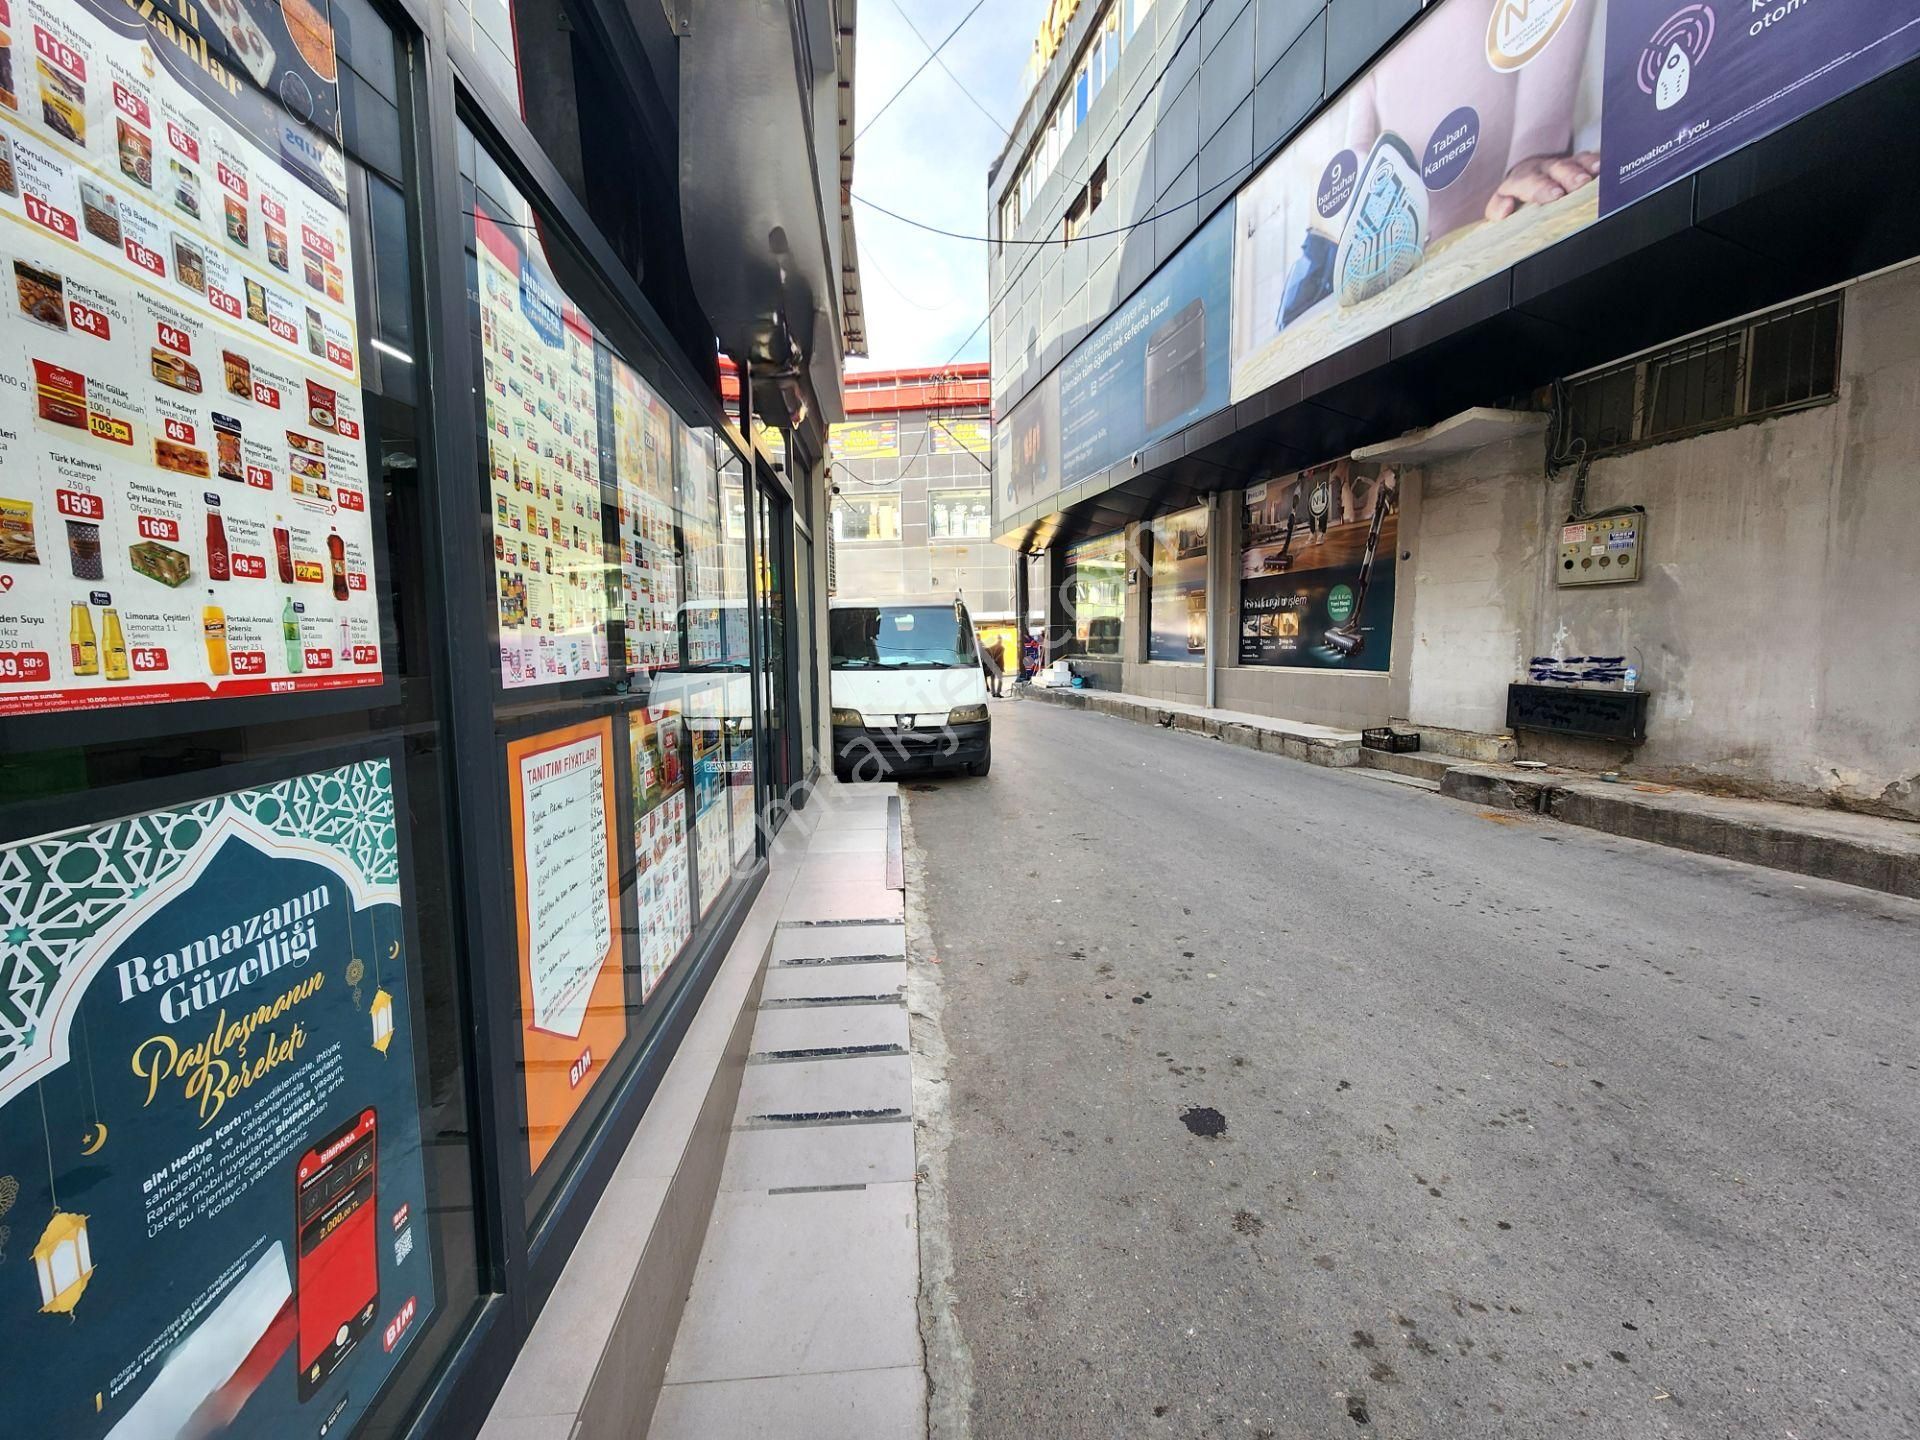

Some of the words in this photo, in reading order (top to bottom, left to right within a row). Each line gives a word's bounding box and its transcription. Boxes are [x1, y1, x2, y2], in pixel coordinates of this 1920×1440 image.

[62, 21, 92, 50] Hurma
[106, 54, 124, 74] Lulu
[1432, 124, 1468, 155] Taban
[1619, 140, 1673, 175] innovation
[1688, 119, 1710, 140] you
[13, 139, 64, 177] Kavrulmuş
[15, 153, 37, 172] Kaju
[1424, 135, 1476, 178] Kamerası
[17, 166, 52, 192] Simbat
[19, 180, 39, 196] 300
[1331, 164, 1342, 184] 9
[1318, 193, 1332, 208] bar
[1332, 171, 1357, 197] buhar
[133, 211, 159, 230] Badem
[66, 276, 92, 296] Peynir
[93, 287, 117, 307] Tatlısı
[87, 376, 104, 389] Mini
[105, 383, 129, 400] Güllaç
[155, 395, 171, 407] Mini
[112, 398, 145, 416] Abdullah
[49, 451, 69, 464] Türk
[70, 456, 102, 472] Kahvesi
[58, 466, 97, 482] Kocatepe
[127, 491, 142, 505] Çay
[142, 495, 167, 507] Hazine
[130, 481, 156, 496] Demlik
[156, 487, 177, 498] Poşet
[20, 616, 45, 629] Suyu
[125, 612, 159, 625] Limonata
[162, 614, 190, 627] Çeşitleri
[126, 622, 164, 634] Lemonatta
[226, 615, 251, 626] Portakal
[20, 640, 34, 652] ml
[244, 633, 262, 644] İçecek
[527, 759, 562, 786] TANITIM
[564, 746, 598, 772] FİYATLARI
[115, 885, 331, 1004] Ramazanın
[159, 918, 319, 1024] Güzelliği
[131, 971, 326, 1108] Paylaşmanın
[199, 1021, 308, 1130] Bereketi
[571, 1049, 591, 1088] BIM
[171, 1137, 213, 1173] Hediye
[215, 1108, 253, 1141] Kartı'nı
[254, 1062, 316, 1112] sevdiklerinizle,
[315, 1041, 342, 1065] ihtiyaç
[147, 1165, 216, 1224] Ramazan'ın
[219, 1114, 280, 1168] mutluluğunu
[282, 1090, 312, 1117] birlikte
[148, 1200, 189, 1239] Üstelik
[192, 1171, 223, 1204] mobil
[226, 1134, 275, 1176] uygulama
[275, 1097, 317, 1137] BİMPARA
[179, 1211, 195, 1230] bu
[244, 1157, 263, 1176] cep
[264, 1101, 329, 1159] telefonunuzdan
[145, 1153, 214, 1209] sahipleriyle
[220, 1137, 234, 1151] ve
[208, 1181, 248, 1219] kolayca
[386, 1300, 414, 1347] BIM
